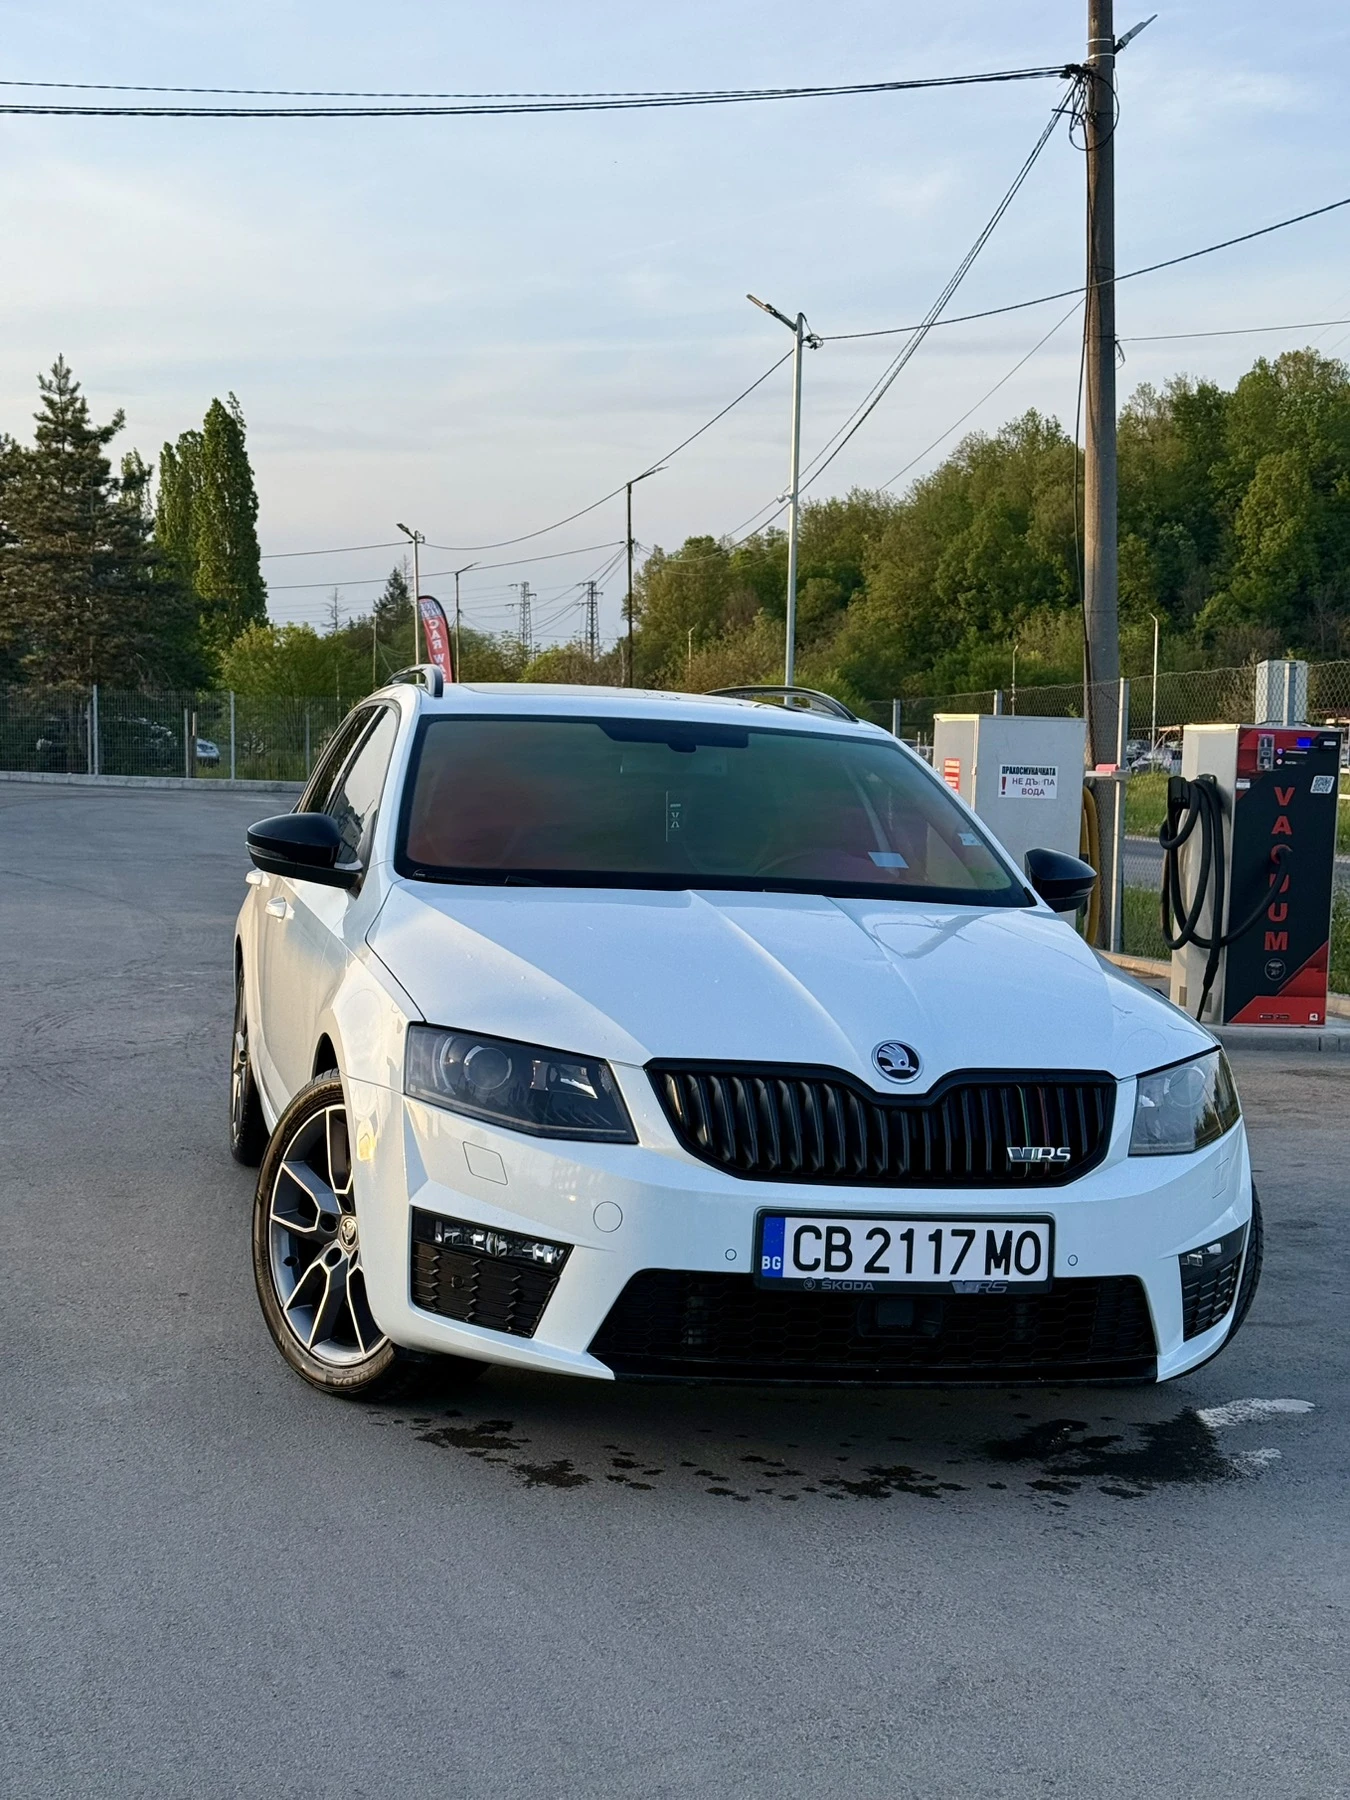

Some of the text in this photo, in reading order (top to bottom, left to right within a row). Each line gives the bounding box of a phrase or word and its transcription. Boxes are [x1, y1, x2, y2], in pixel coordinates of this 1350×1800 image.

[1012, 777, 1024, 786] НЕ
[1021, 787, 1045, 797] ВОДА
[793, 1224, 1042, 1276] CB 2117 MO
[761, 1255, 782, 1270] BG
[821, 1277, 875, 1291] ŠKODA
